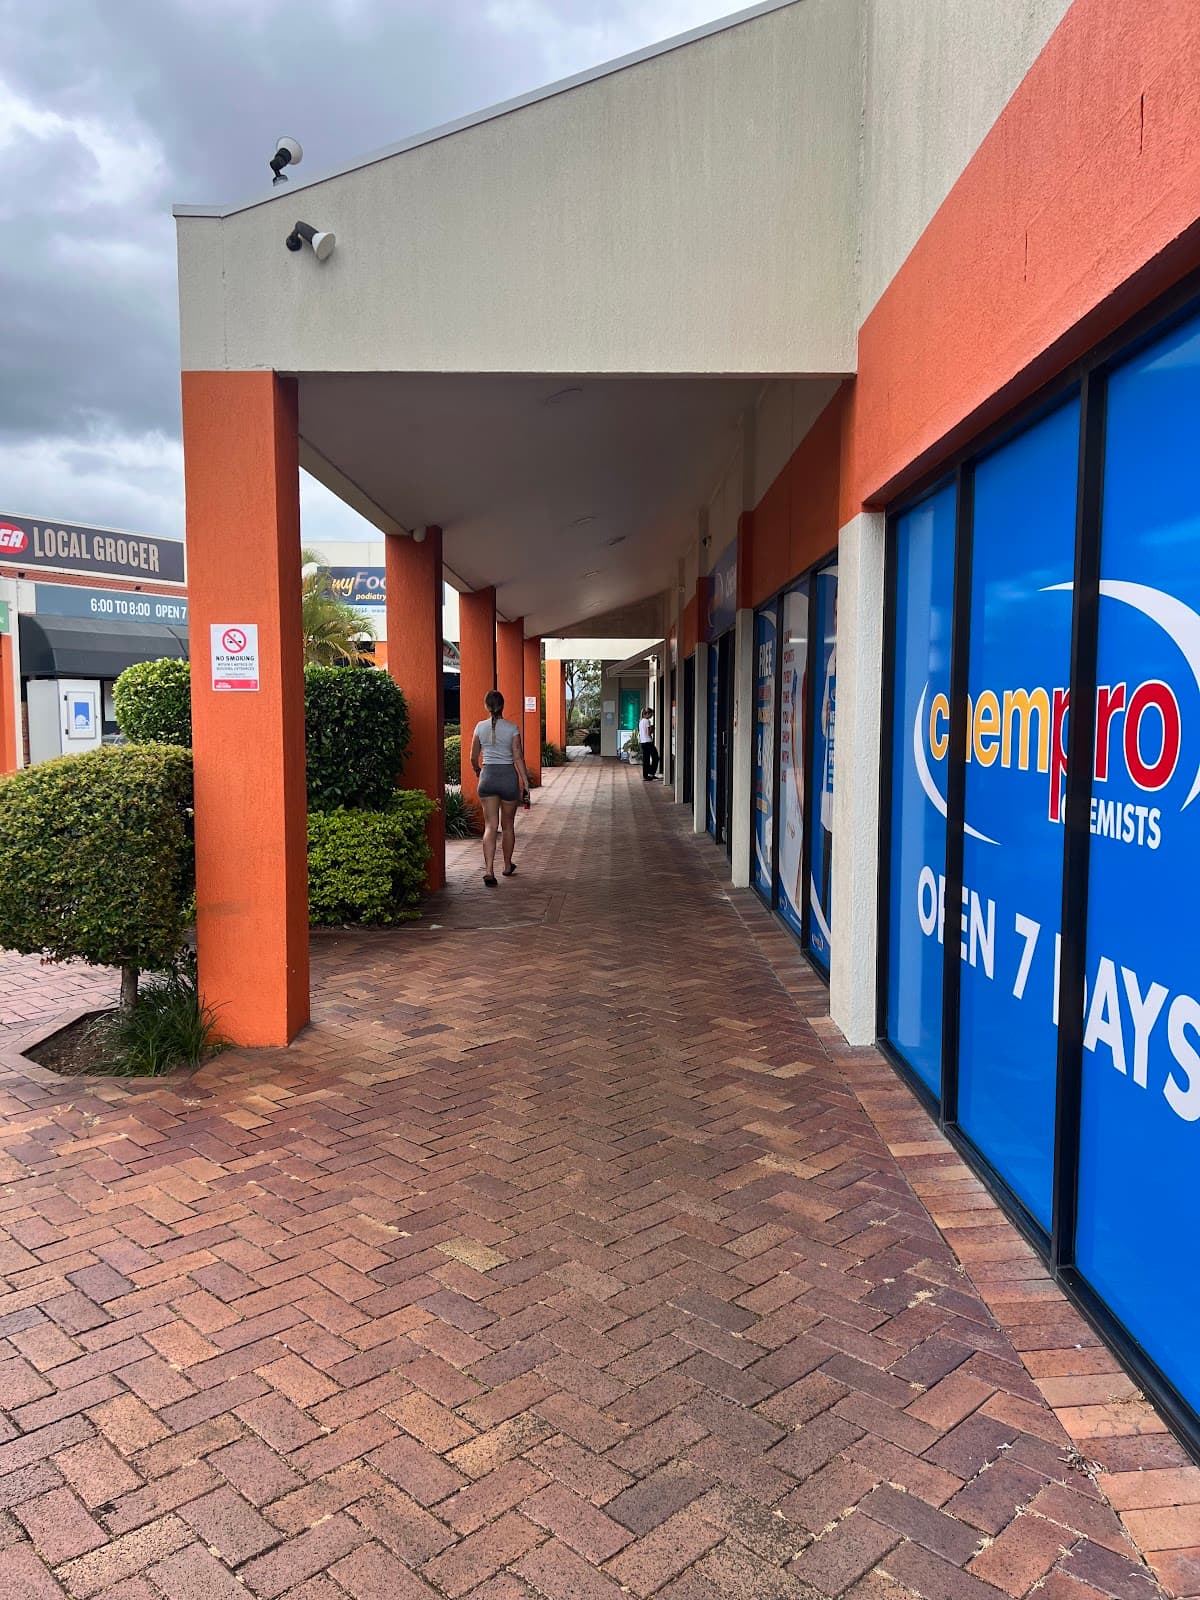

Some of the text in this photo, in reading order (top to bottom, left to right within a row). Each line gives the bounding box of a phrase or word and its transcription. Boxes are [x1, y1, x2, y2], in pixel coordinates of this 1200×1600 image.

[0, 528, 24, 548] GA
[33, 526, 160, 573] LOCAL GROCER
[90, 598, 188, 619] 6:00 TO 8:00 OPEN 7
[355, 592, 387, 602] podiatry
[758, 641, 773, 678] FREE
[929, 679, 1182, 823] cempro
[1061, 793, 1162, 850] EMISTS
[1012, 912, 1041, 1000] 7
